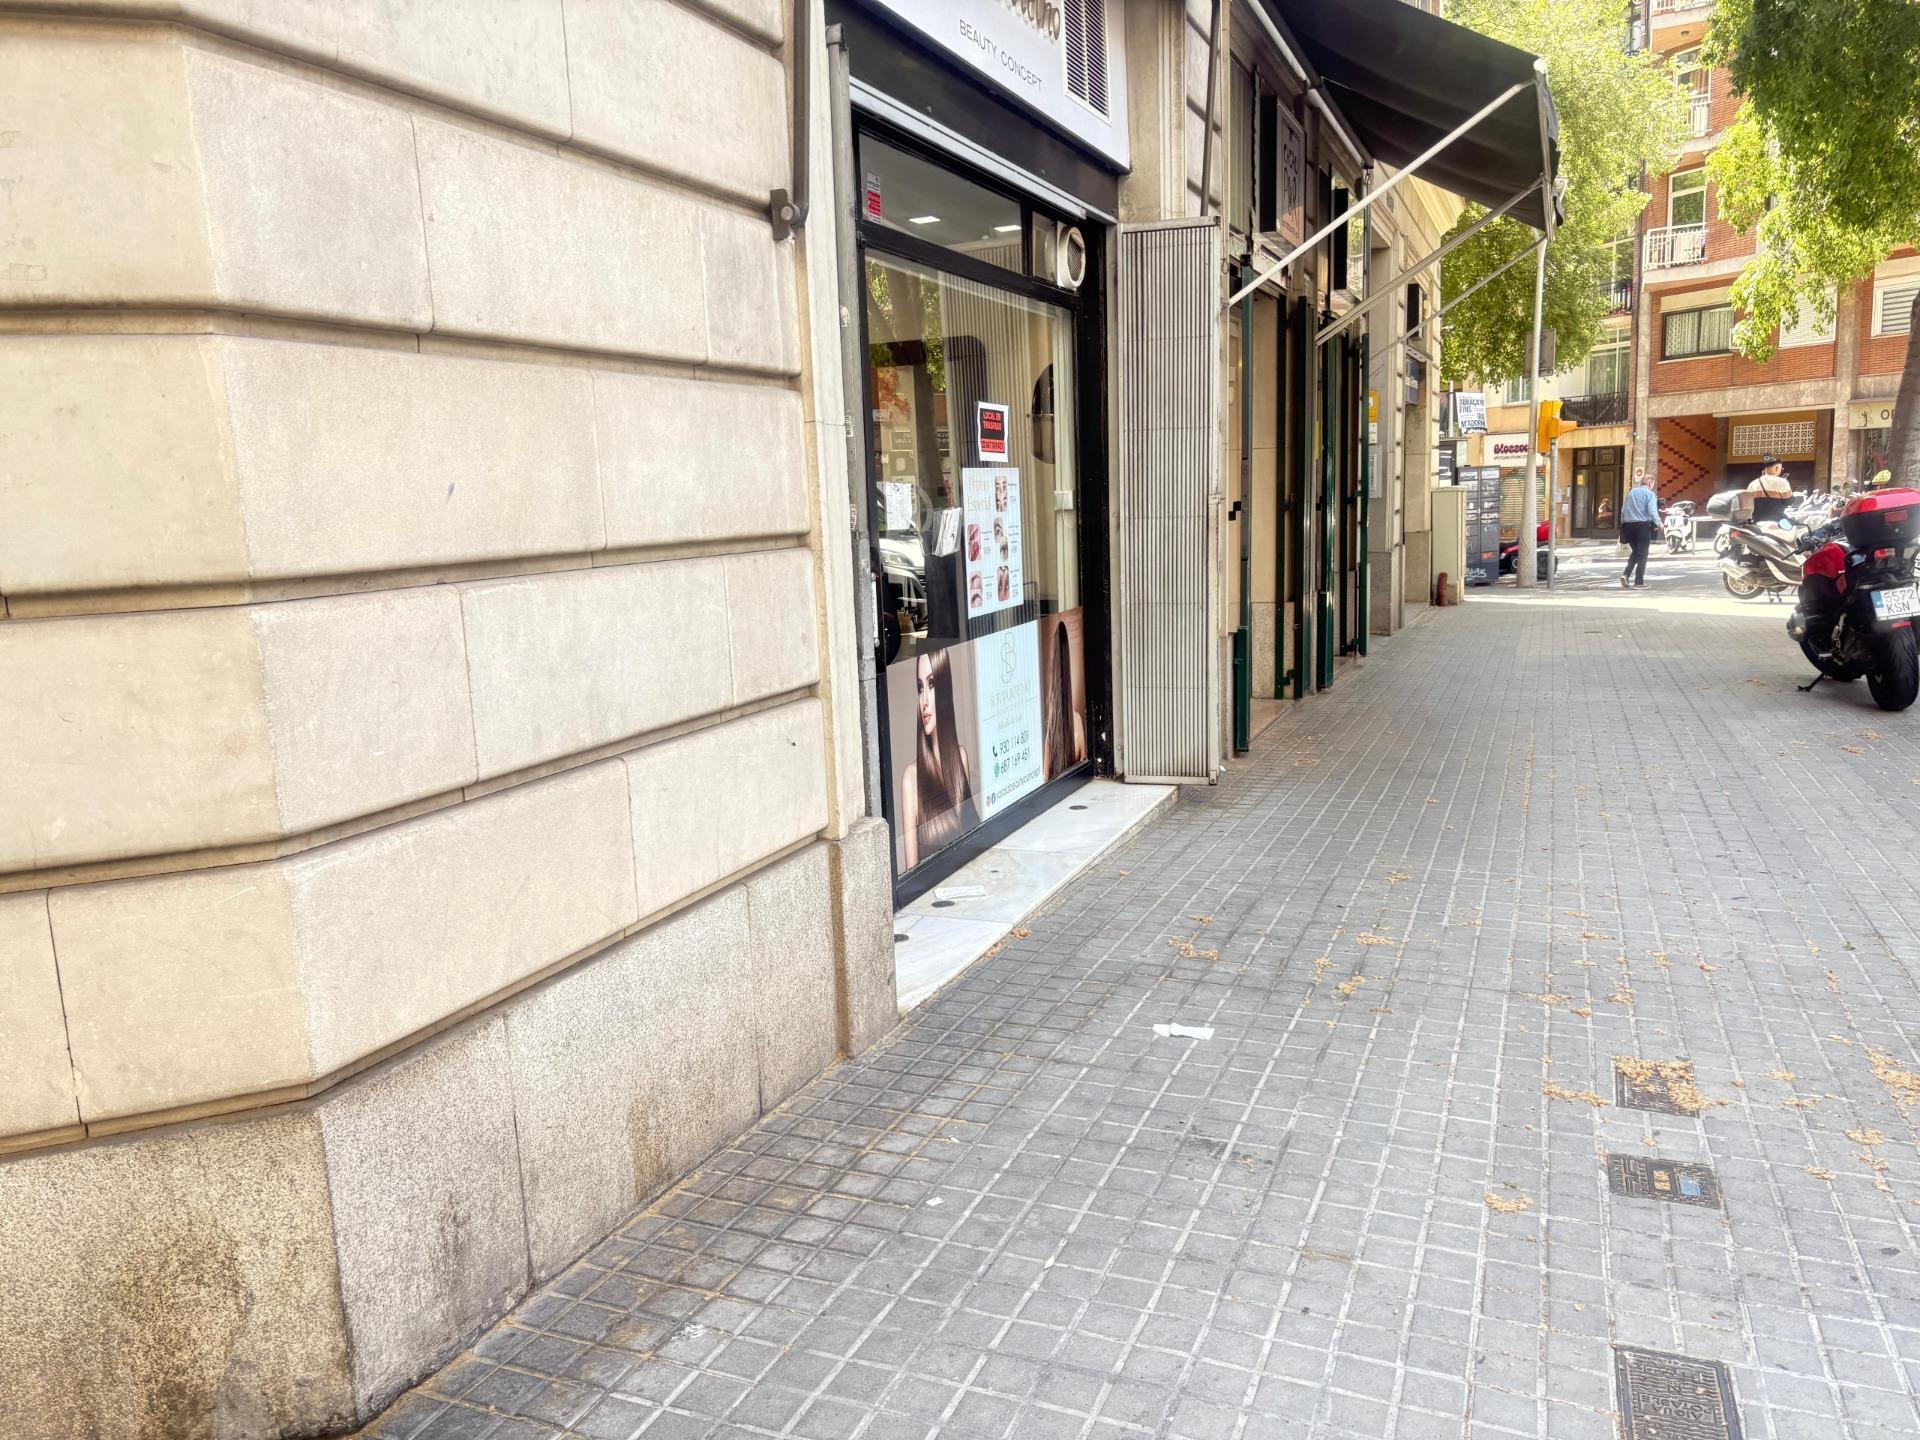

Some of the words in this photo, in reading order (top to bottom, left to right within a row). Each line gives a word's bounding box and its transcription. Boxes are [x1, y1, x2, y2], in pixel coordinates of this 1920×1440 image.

[959, 18, 997, 58] BEAUTY
[1000, 50, 1043, 90] CONCEPT
[1459, 405, 1472, 414] FINS
[1883, 588, 1916, 603] 5572
[1886, 601, 1911, 614] KSN
[1000, 739, 1010, 756] 930
[1011, 734, 1020, 749] 114
[1001, 757, 1011, 774] 687
[1011, 751, 1021, 768] 169
[1641, 1394, 1714, 1415] POTABLE
[1652, 1404, 1704, 1420] AIGUA
